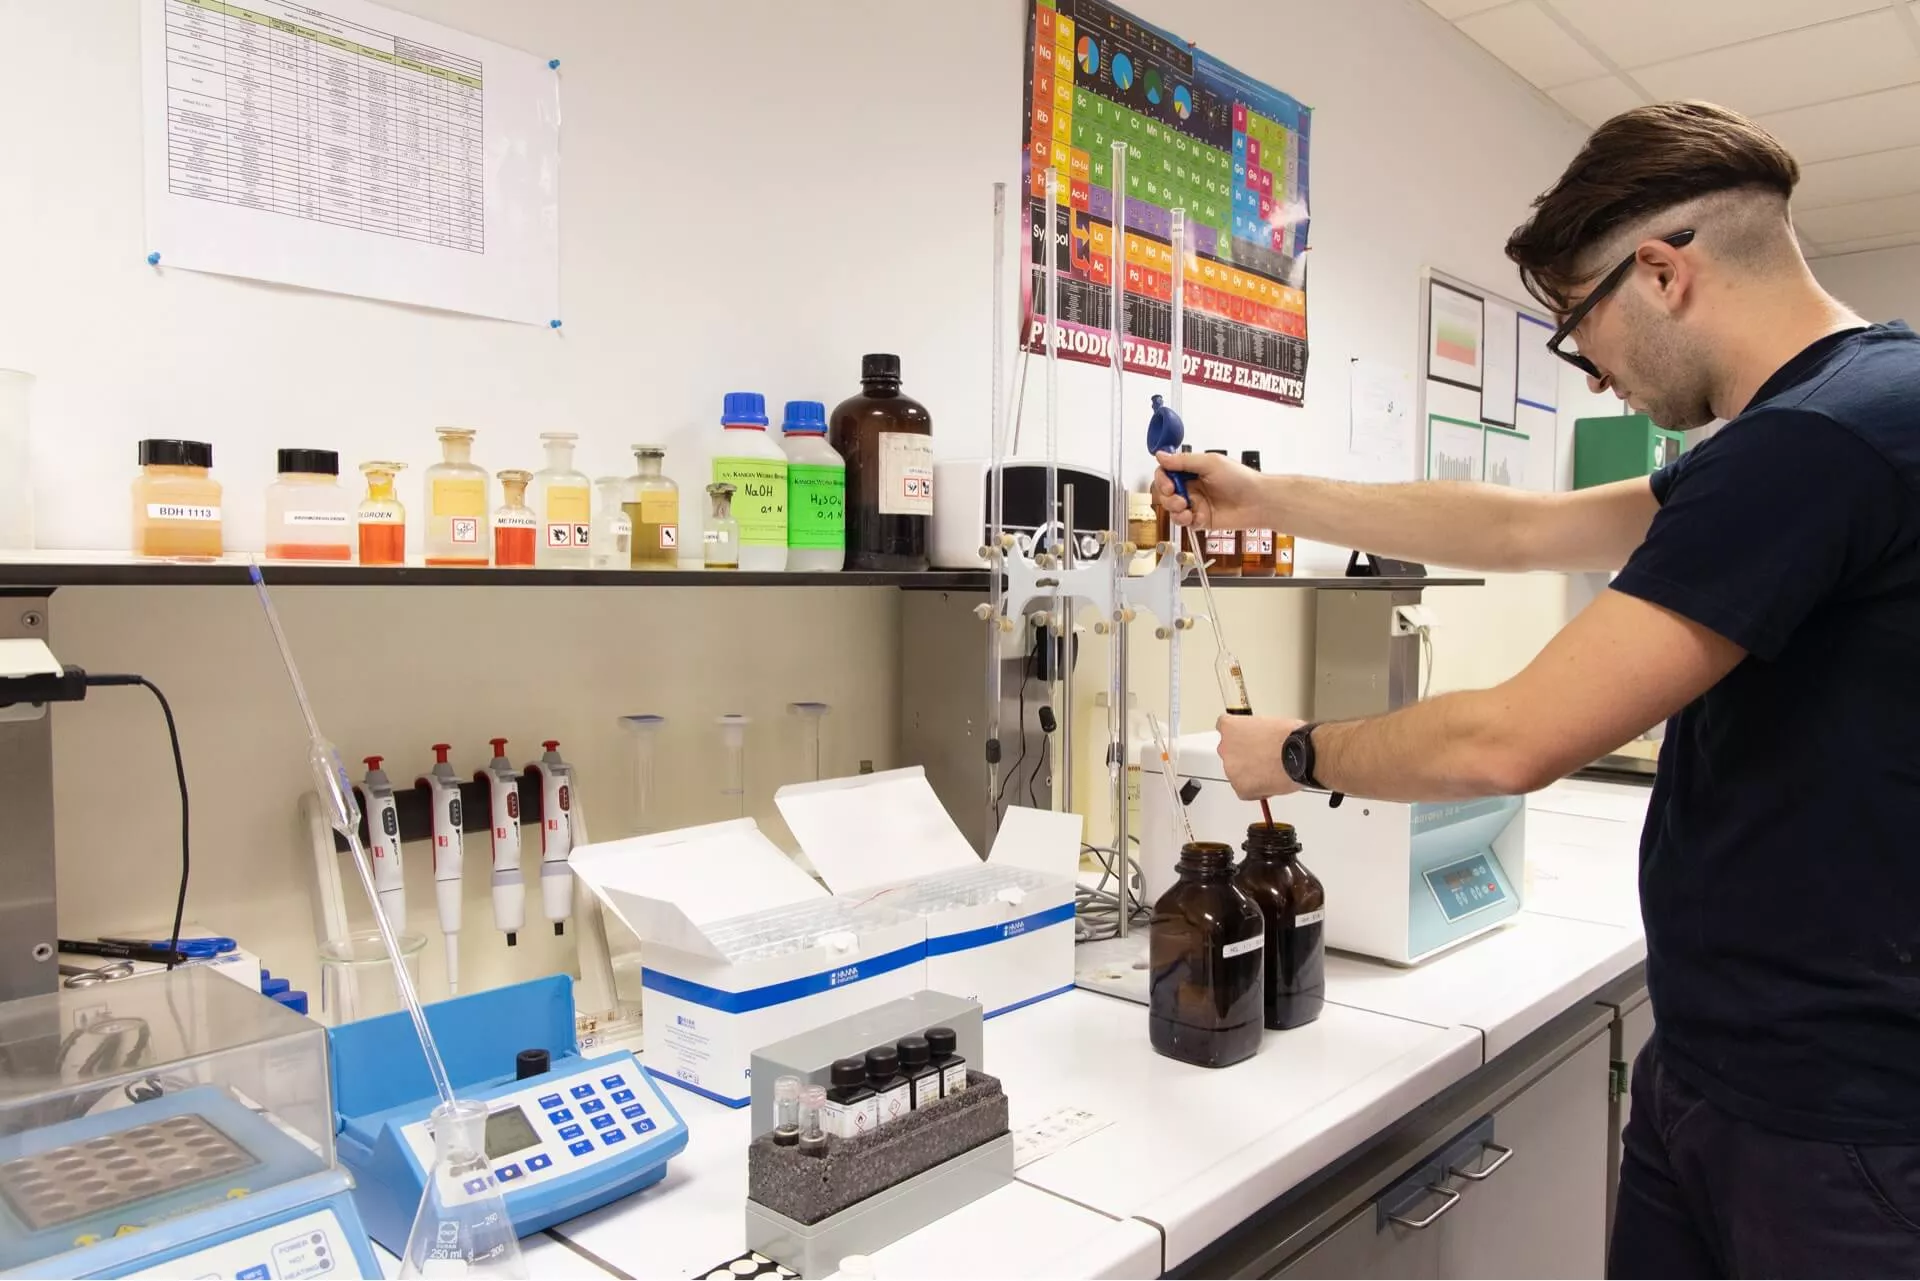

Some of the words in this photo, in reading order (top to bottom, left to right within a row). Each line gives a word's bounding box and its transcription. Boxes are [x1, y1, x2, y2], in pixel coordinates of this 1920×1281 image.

[1040, 44, 1051, 60] Na
[1058, 54, 1071, 71] Mg
[1041, 78, 1047, 92] K
[1078, 94, 1086, 107] Sc
[1037, 110, 1048, 124] Rb
[1115, 111, 1120, 121] V
[1130, 118, 1139, 129] Cr
[1078, 126, 1083, 137] Y
[1146, 124, 1157, 136] Mn
[1096, 133, 1103, 144] Zr
[1164, 131, 1171, 144] Fe
[1035, 142, 1046, 156] Cs
[1176, 139, 1185, 151] Co
[1129, 146, 1141, 160] Mo
[1206, 152, 1215, 163] Cu
[1095, 163, 1103, 175] Hf
[1221, 158, 1229, 168] Zn
[1131, 176, 1139, 187] W
[1192, 173, 1200, 184] Pd
[1248, 169, 1257, 182] Ge
[1147, 182, 1157, 194] Re
[1206, 180, 1215, 192] Ag
[1220, 185, 1229, 196] Cd
[1163, 188, 1172, 200] Os
[1206, 206, 1214, 217] Au
[1033, 224, 1068, 246] Sybol
[1094, 231, 1103, 242] La
[1146, 246, 1156, 257] Nd
[1130, 270, 1139, 281] Pa
[1148, 275, 1153, 285] U
[1182, 354, 1201, 376] OF
[1203, 359, 1233, 384] THE
[1234, 366, 1303, 399] ELEMENTS
[745, 484, 773, 496] NaOH
[160, 507, 183, 516] BDH
[189, 508, 211, 517] 1113
[431, 1248, 448, 1258] 250
[450, 1249, 462, 1258] ml
